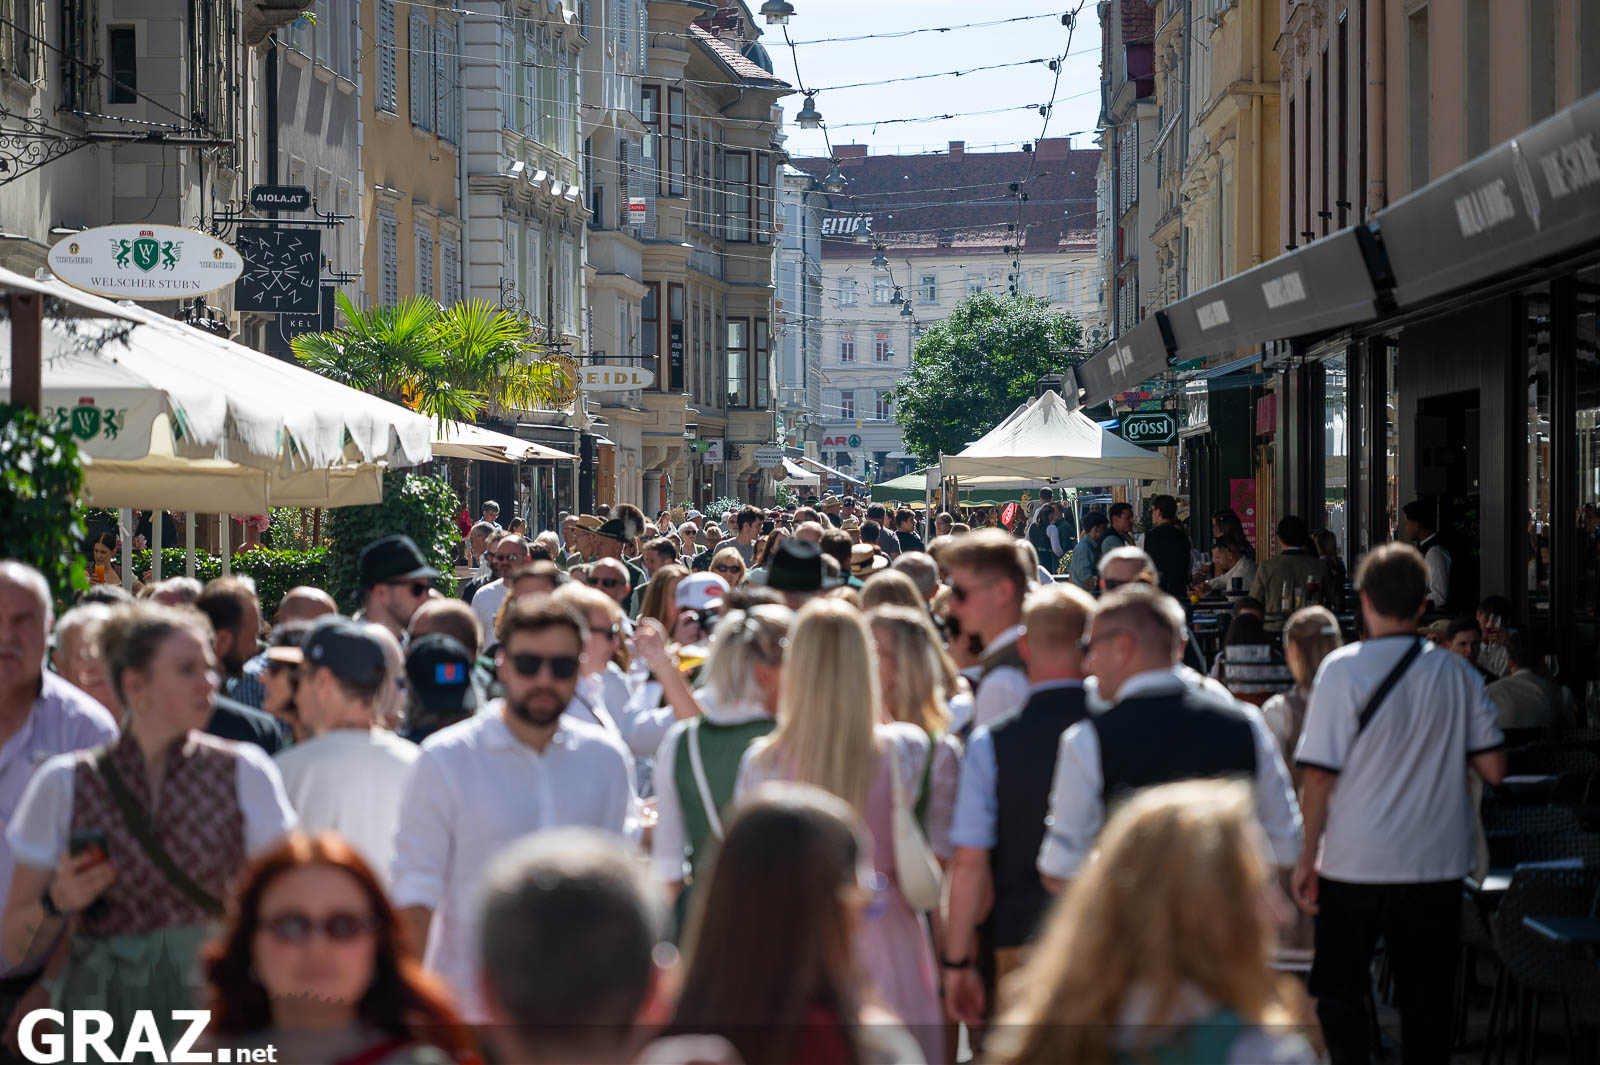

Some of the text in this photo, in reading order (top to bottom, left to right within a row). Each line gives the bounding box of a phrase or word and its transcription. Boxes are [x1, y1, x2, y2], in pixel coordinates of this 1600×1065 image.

[256, 193, 304, 203] AIOLA.AT
[90, 276, 201, 290] WELSCHER STUB'N
[290, 320, 312, 328] KEL
[1128, 419, 1169, 439] gössl
[822, 436, 847, 447] AR
